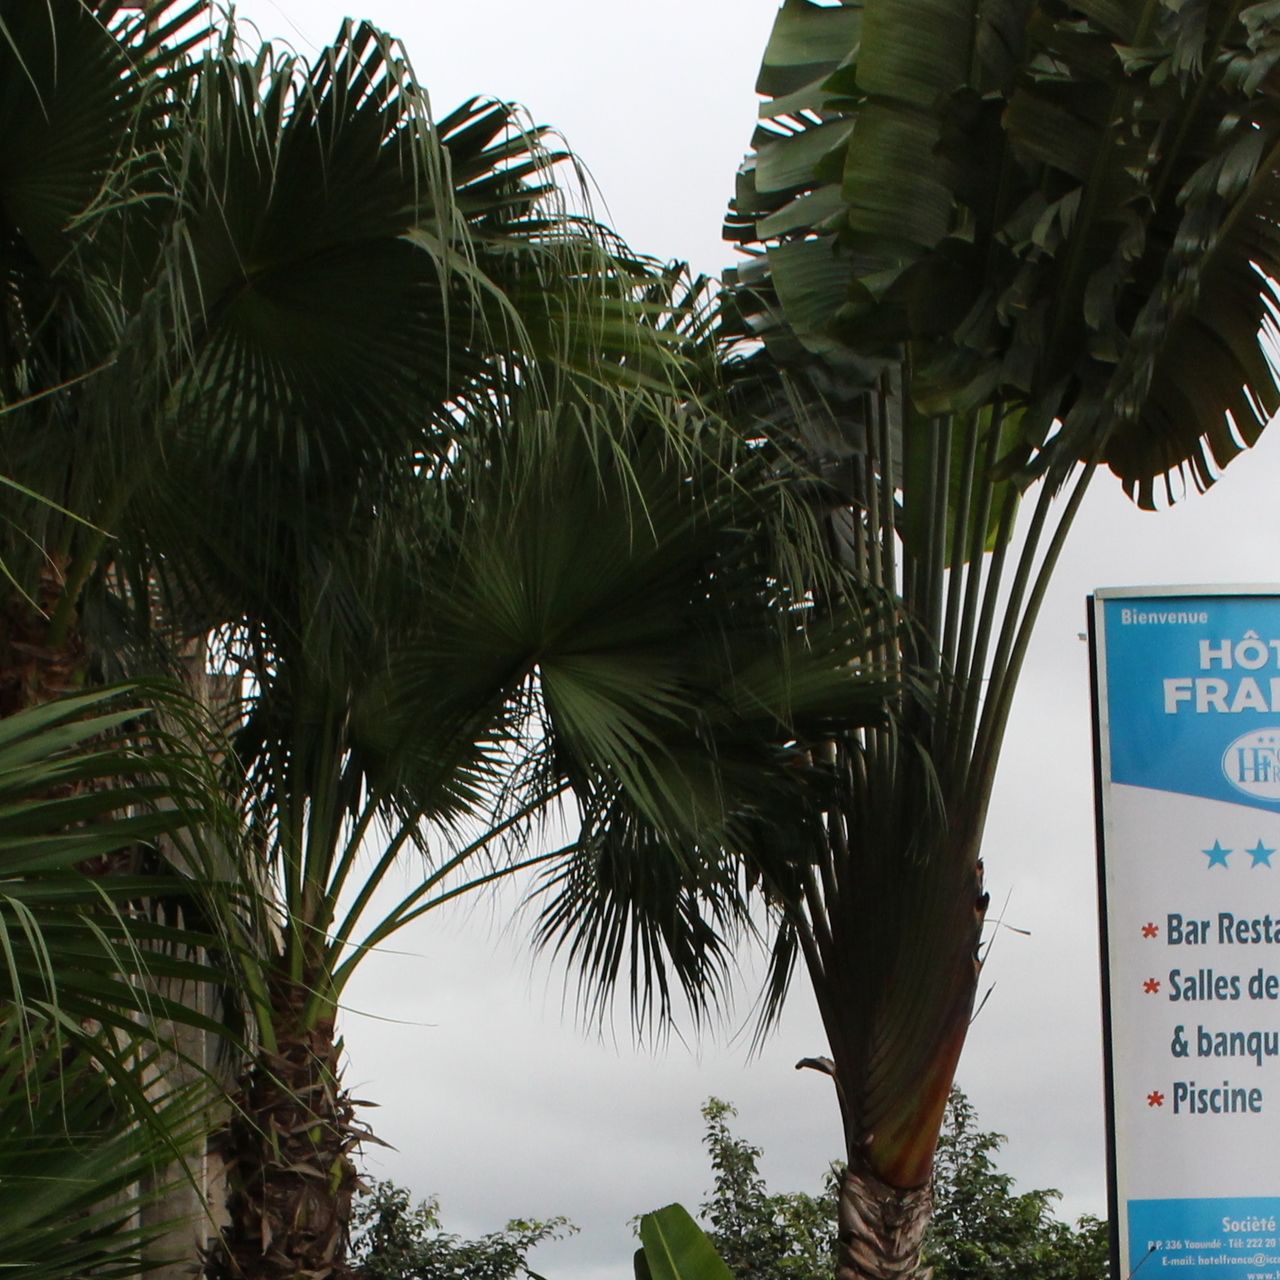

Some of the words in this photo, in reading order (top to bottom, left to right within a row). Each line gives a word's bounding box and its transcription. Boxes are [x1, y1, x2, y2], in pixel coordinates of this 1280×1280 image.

[1121, 609, 1208, 625] Bienvenue
[1167, 913, 1210, 945] Bar
[1169, 969, 1241, 1001] Salles
[1248, 968, 1279, 1001] de
[1171, 1025, 1189, 1058] &
[1173, 1081, 1263, 1114] Piscine
[1246, 1238, 1264, 1248] 222
[1265, 1238, 1276, 1248] 20
[1162, 1255, 1195, 1266] E-mail:
